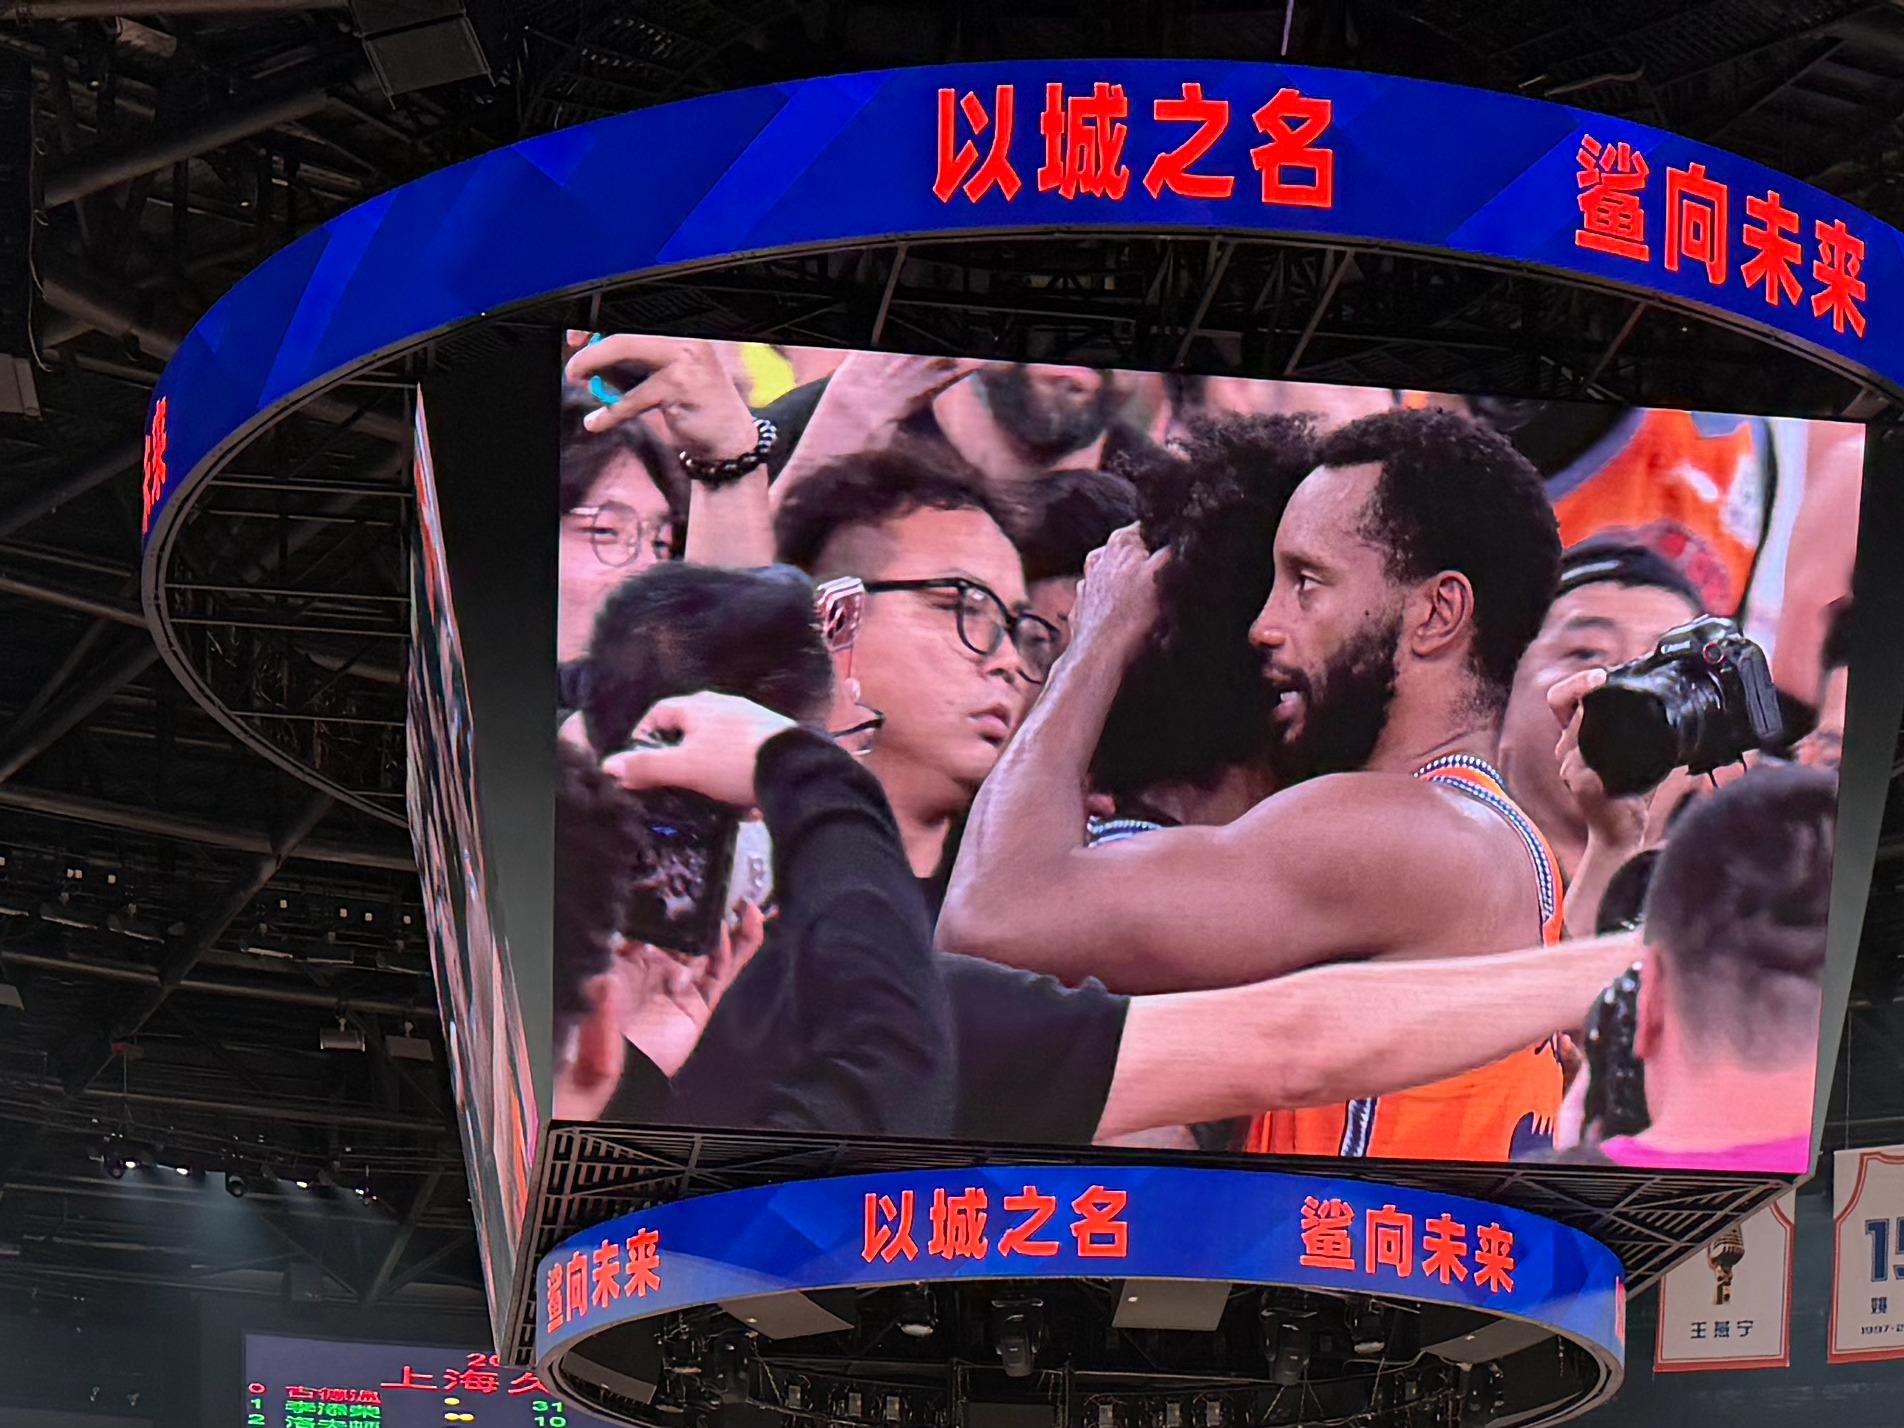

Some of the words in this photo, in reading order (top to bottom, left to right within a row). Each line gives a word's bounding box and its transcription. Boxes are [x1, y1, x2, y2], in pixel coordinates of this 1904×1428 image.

[934, 83, 1334, 209] 以城之名
[1576, 135, 1867, 337] 鲨向未来
[862, 1186, 1128, 1262] 以城之名
[1301, 1197, 1515, 1292] 鲨向未来
[548, 1229, 661, 1333] 鲨向未来
[248, 1383, 266, 1395] 0
[248, 1414, 265, 1426] 2
[533, 1416, 567, 1428] 10
[250, 1398, 262, 1410] 1
[531, 1400, 565, 1412] 31
